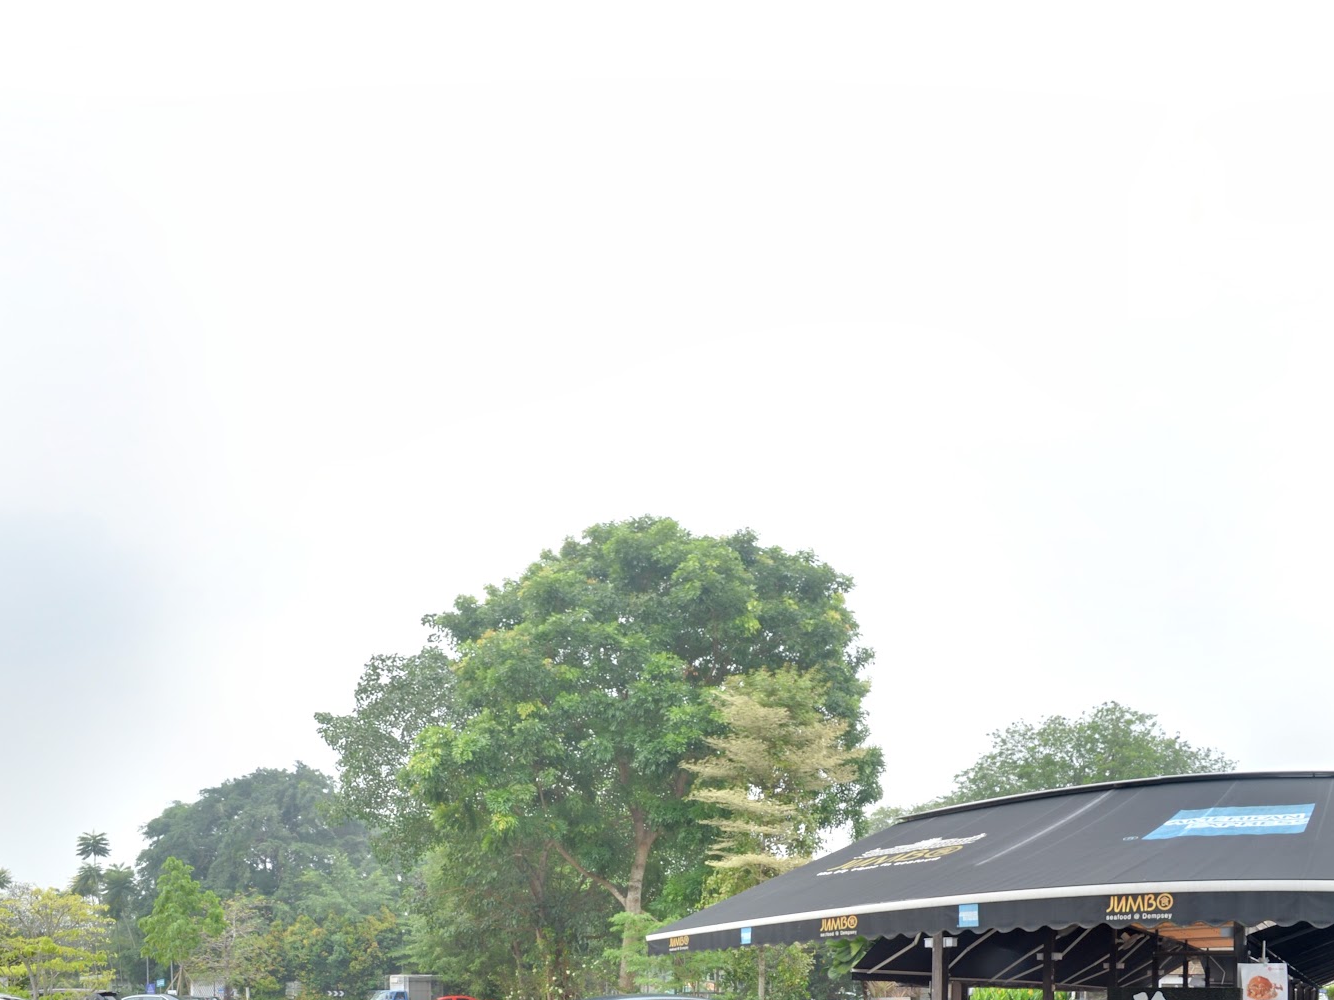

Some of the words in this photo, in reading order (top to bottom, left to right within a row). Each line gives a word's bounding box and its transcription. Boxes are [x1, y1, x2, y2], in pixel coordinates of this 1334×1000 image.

[1106, 893, 1173, 913] JUMBO
[820, 915, 858, 931] JUMBO
[669, 935, 689, 947] JUMBO
